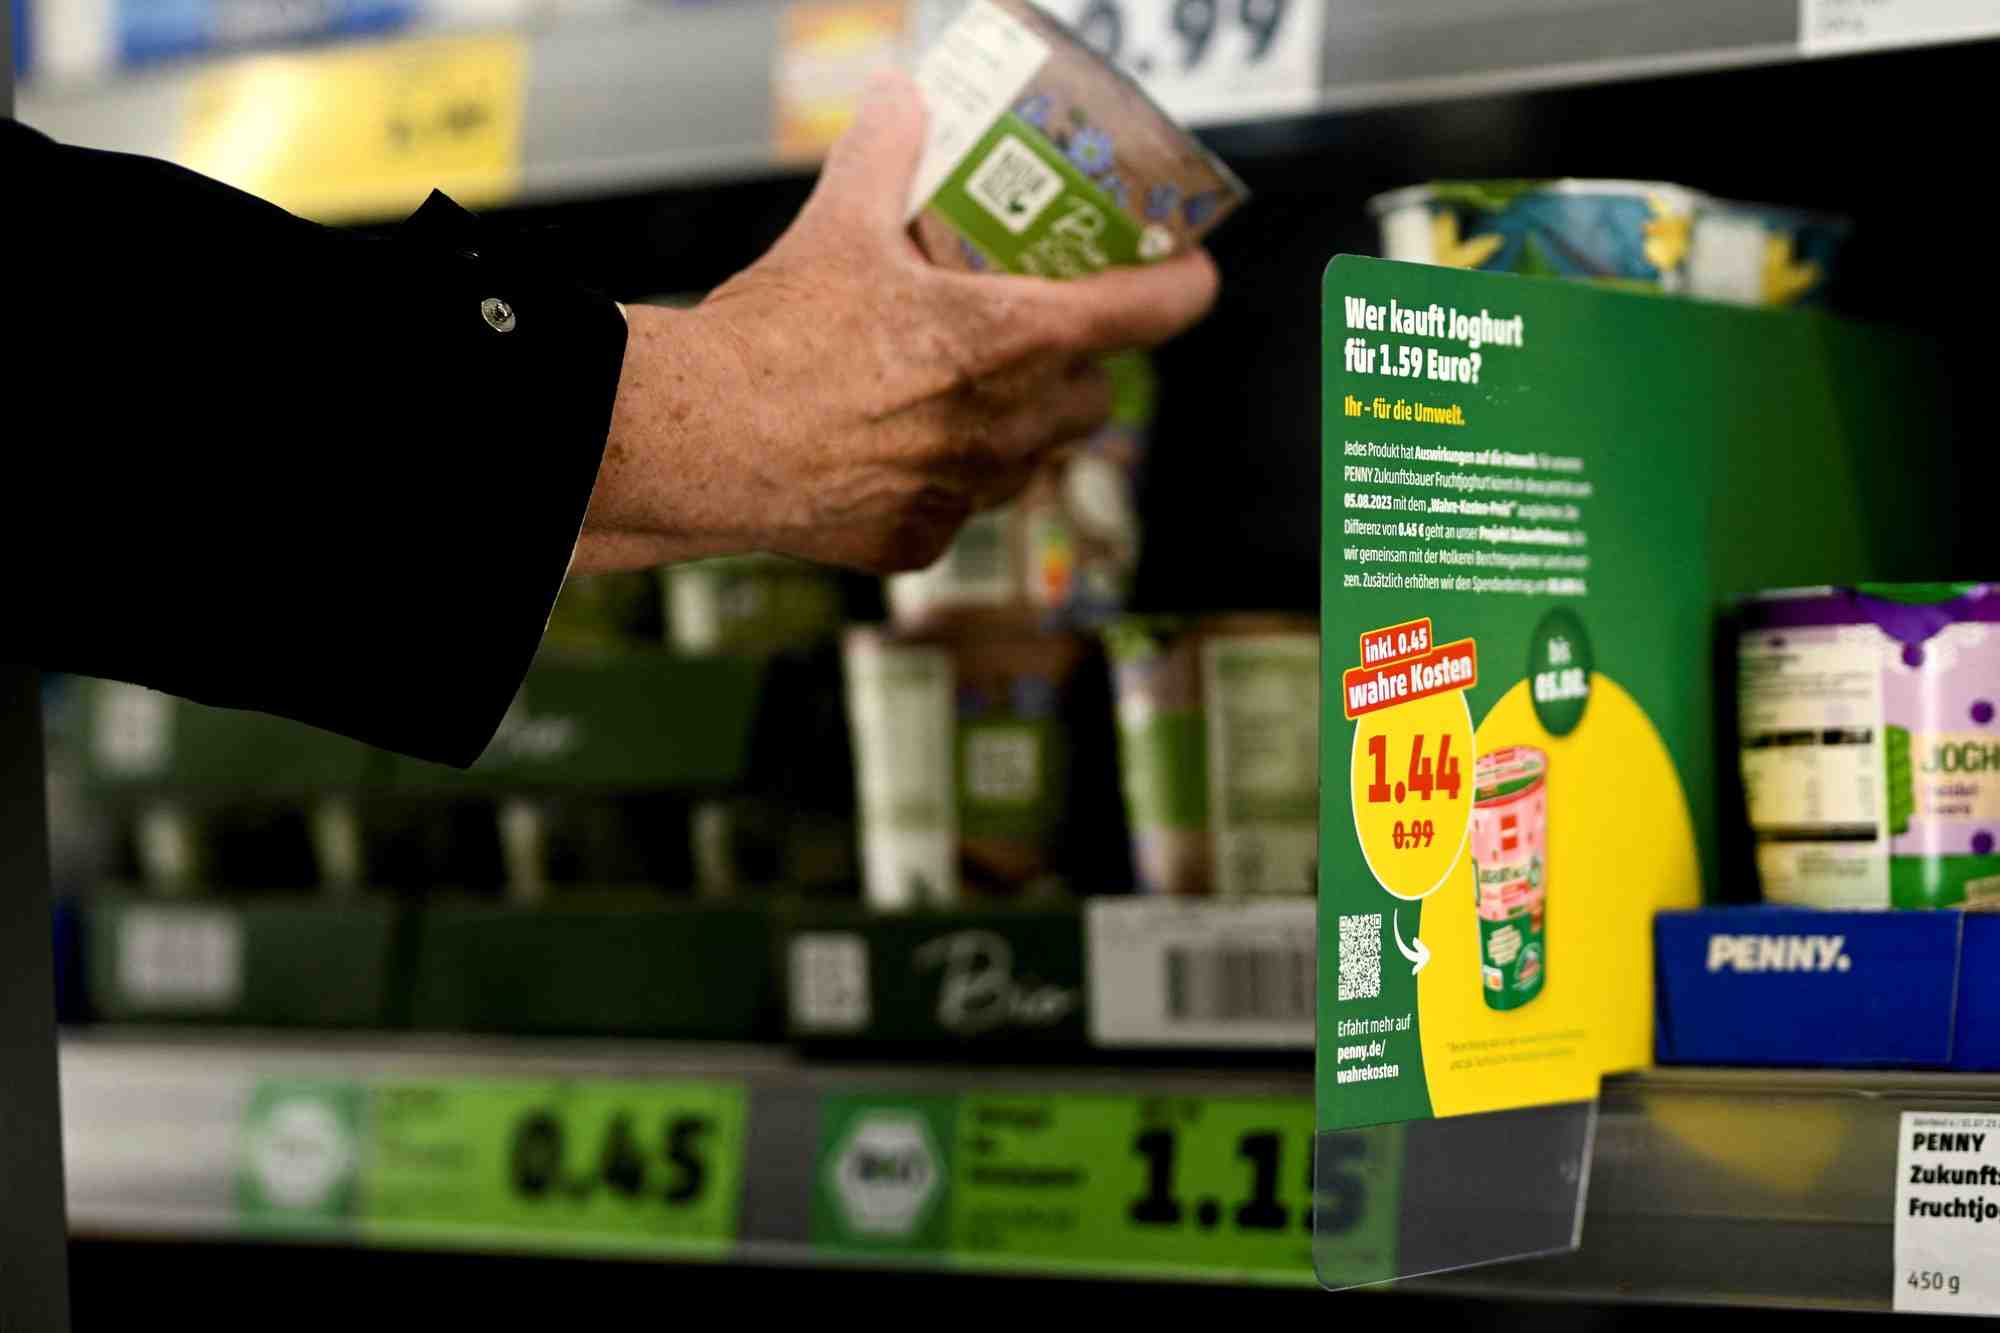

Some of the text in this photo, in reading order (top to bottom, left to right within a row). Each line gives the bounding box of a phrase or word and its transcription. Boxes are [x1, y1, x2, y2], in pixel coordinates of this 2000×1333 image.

[1344, 296, 1524, 349] Wer kauft Joghurt
[1344, 338, 1482, 385] für 1.59 Euro?
[1344, 394, 1362, 417] Ihr
[1373, 397, 1391, 419] für
[1393, 400, 1412, 421] die
[1414, 402, 1465, 426] Umwelt.
[1344, 441, 1367, 456] Jedes
[1368, 443, 1400, 459] Produkt
[1401, 444, 1415, 459] hat
[1415, 445, 1475, 466] Auswirkungen
[1344, 466, 1373, 482] PENNY
[1374, 467, 1434, 487] Zukunftsbauer
[1344, 493, 1392, 510] 05.08.2023
[1393, 496, 1407, 511] mit
[1408, 496, 1426, 512] dem
[1344, 519, 1381, 535] Differenz
[1382, 523, 1397, 536] von
[1398, 522, 1417, 537] 0.45
[1418, 523, 1425, 537] €
[1425, 523, 1444, 541] geht
[1445, 527, 1456, 539] an
[1456, 527, 1478, 540] unser
[1344, 545, 1358, 560] wir
[1360, 547, 1408, 564] gemeinsam
[1409, 547, 1423, 562] mit
[1424, 548, 1438, 563] der
[1439, 548, 1474, 566] Molkerei
[1344, 574, 1361, 587] zen.
[1362, 572, 1404, 588] Zusätzlich
[1405, 574, 1439, 589] erhöhen
[1441, 574, 1455, 590] wir
[1456, 575, 1472, 590] den
[1365, 628, 1428, 663] inkl. 0.45
[1348, 655, 1473, 710] wahre Kosten
[1368, 733, 1461, 804] 1.44
[1392, 819, 1434, 849] 0.99
[1707, 934, 1851, 973] PENNY.
[1338, 1013, 1411, 1037] Erfahrt mehr auf
[1337, 1039, 1386, 1064] penny.de/
[1337, 1063, 1399, 1084] wahrekosten
[1912, 1132, 1985, 1152] PENNY
[1128, 1128, 1368, 1236] 1.15
[1910, 1164, 2000, 1186] Zukunft
[1909, 1196, 2000, 1223] Fruchtjo
[1907, 1271, 1960, 1294] 450 g
